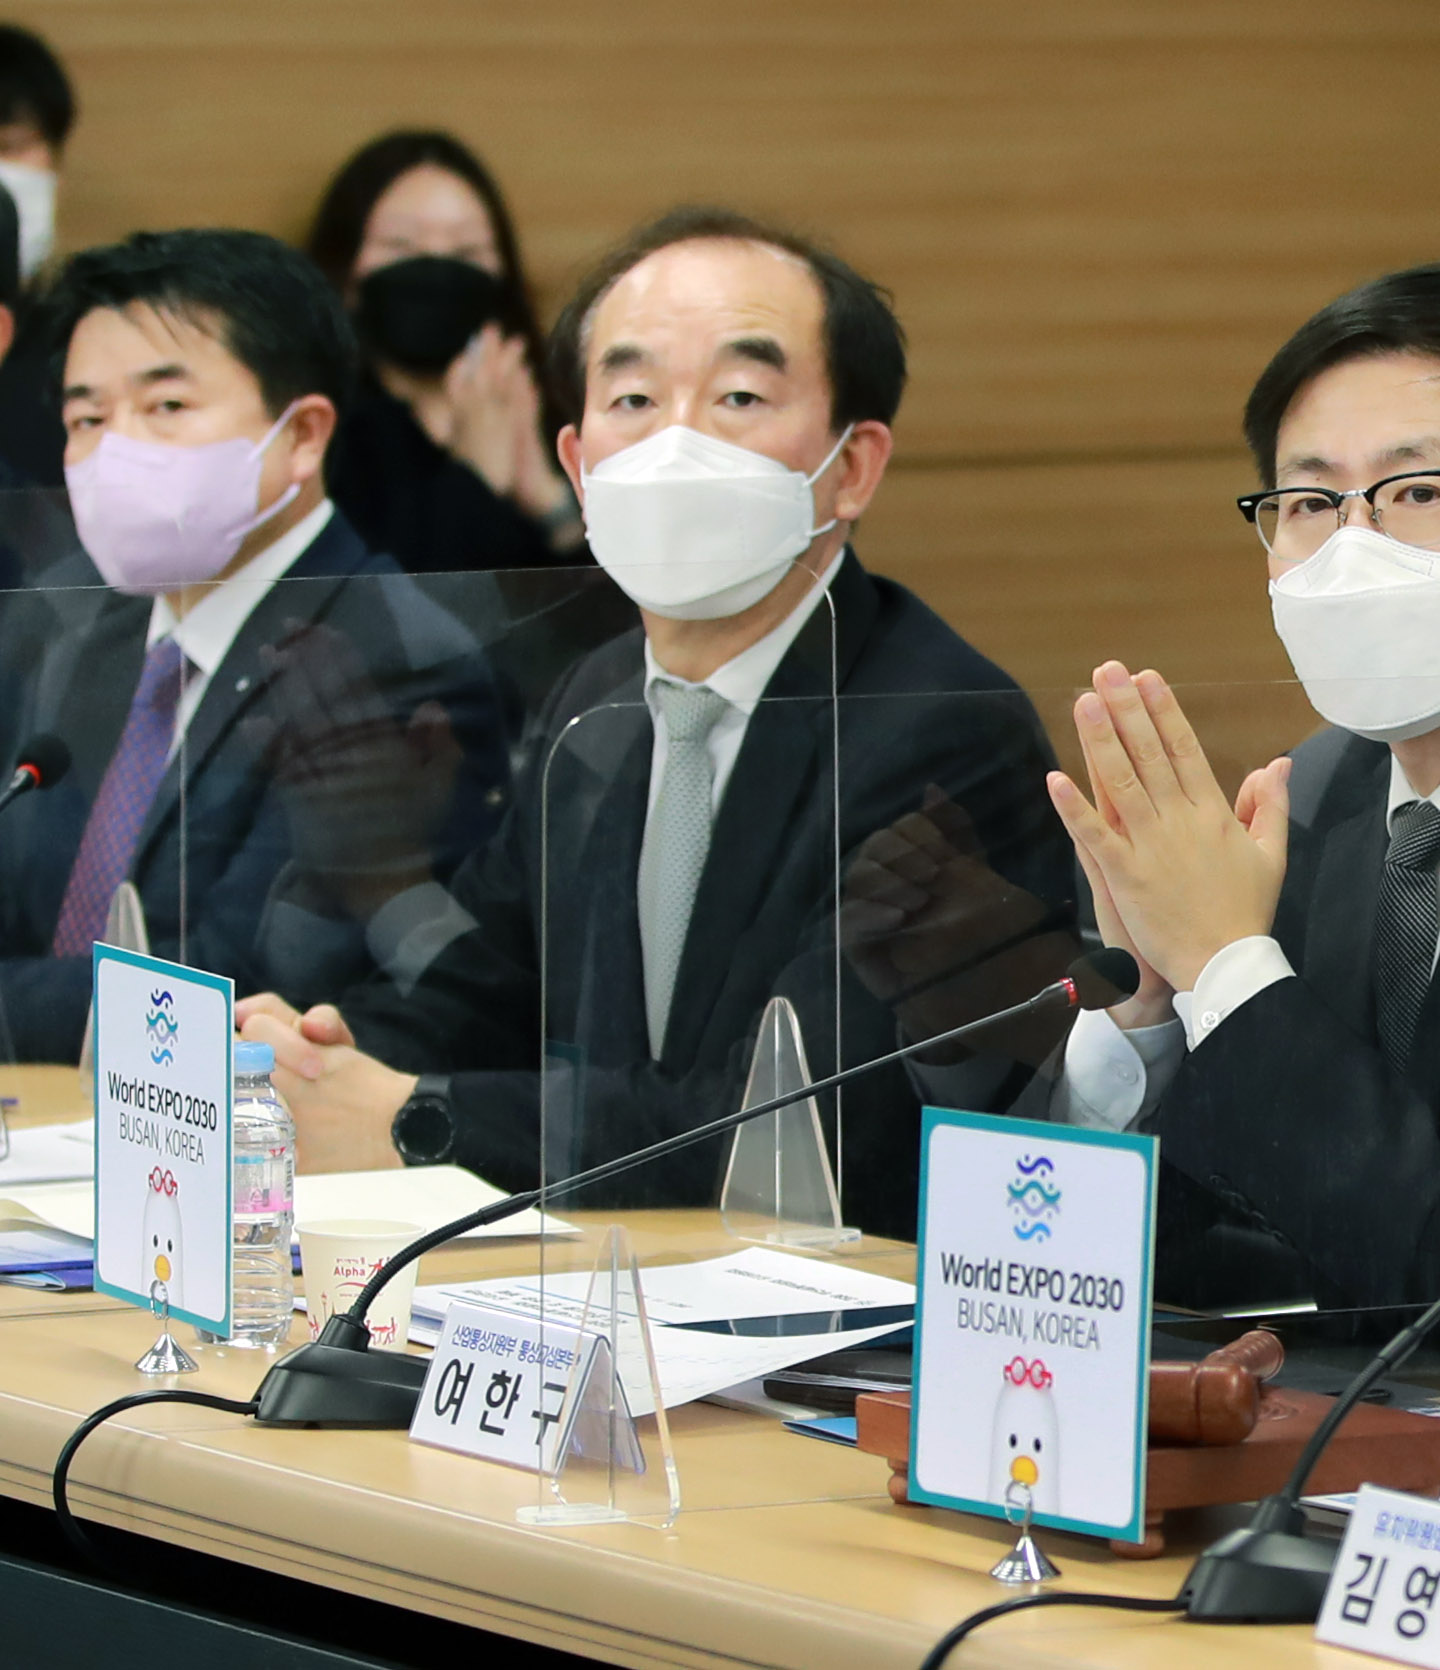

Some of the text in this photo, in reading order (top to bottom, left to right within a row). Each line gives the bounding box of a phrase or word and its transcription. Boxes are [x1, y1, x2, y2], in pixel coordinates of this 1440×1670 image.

[107, 1070, 217, 1132] World EXPO 2030
[120, 1112, 205, 1166] BUSAN, KOREA
[333, 1266, 366, 1277] Alpha
[941, 1251, 1125, 1312] World EXPO 2030
[451, 1324, 518, 1358] 산업통상자원부
[957, 1297, 1100, 1351] BUSAN, KOREA
